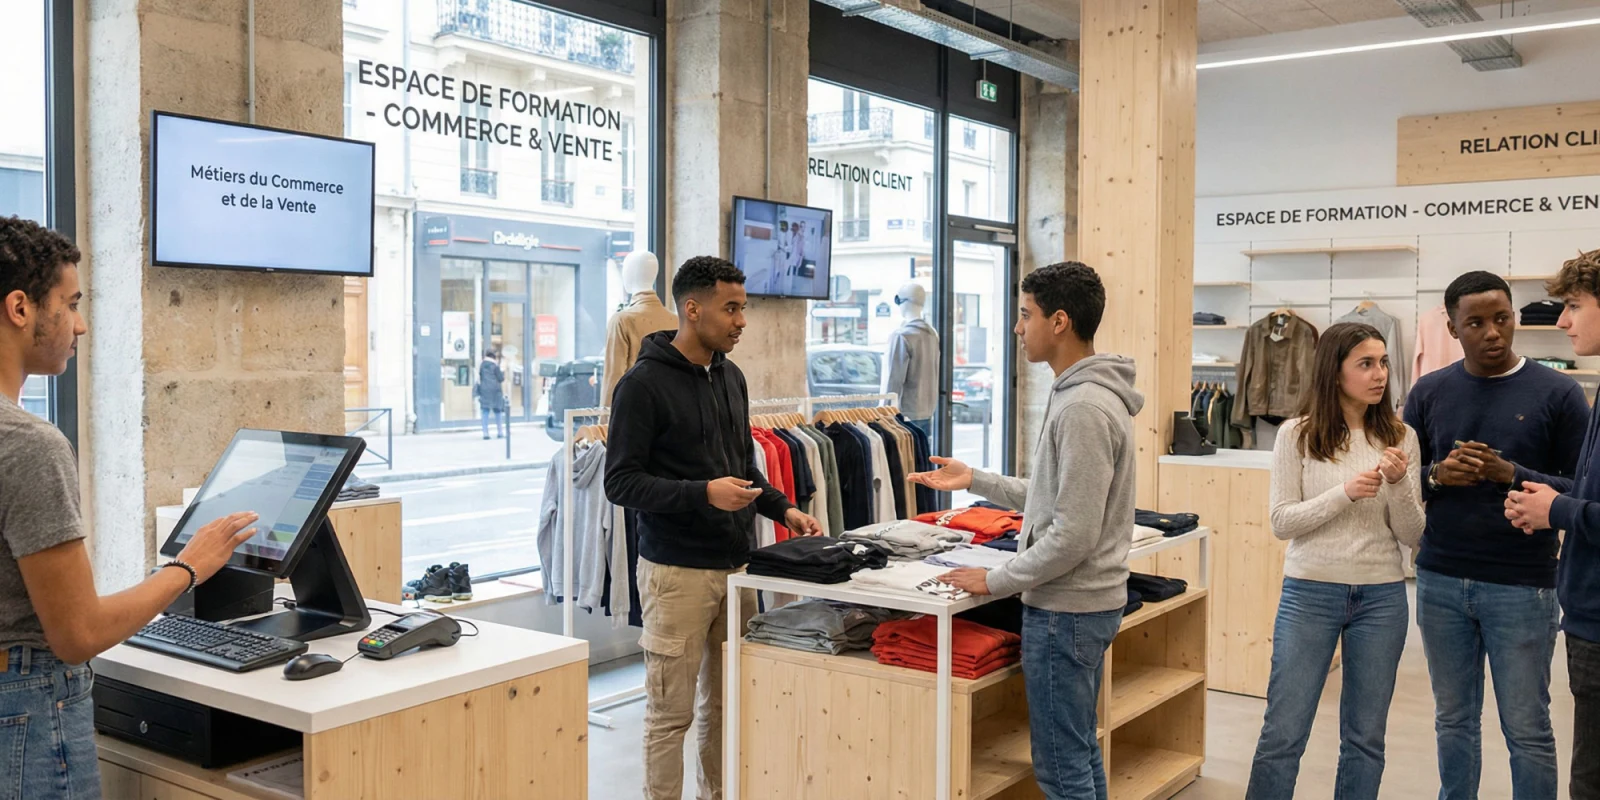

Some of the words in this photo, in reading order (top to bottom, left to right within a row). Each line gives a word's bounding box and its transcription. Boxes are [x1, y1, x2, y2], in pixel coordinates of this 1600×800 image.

[358, 59, 455, 101] ESPACE
[462, 80, 493, 108] DE
[499, 87, 621, 131] FORMATION
[384, 103, 522, 147] COMMERCE
[529, 127, 543, 151] &
[547, 131, 613, 162] VENTE
[1460, 132, 1559, 154] RELATION
[1565, 129, 1600, 147] CLI
[191, 164, 246, 184] Métiers
[249, 171, 268, 187] du
[271, 174, 344, 195] Commerce
[808, 157, 870, 185] RELATION
[872, 169, 913, 192] CLIENT
[221, 193, 236, 207] et
[240, 193, 258, 209] de
[261, 194, 274, 210] la
[277, 196, 317, 214] Vente
[1216, 210, 1276, 227] ESPACE
[1280, 209, 1302, 224] DE
[1306, 203, 1408, 222] FORMATION
[1424, 197, 1534, 217] COMMERCE
[1538, 196, 1553, 212] &
[1557, 194, 1600, 211] VEN
